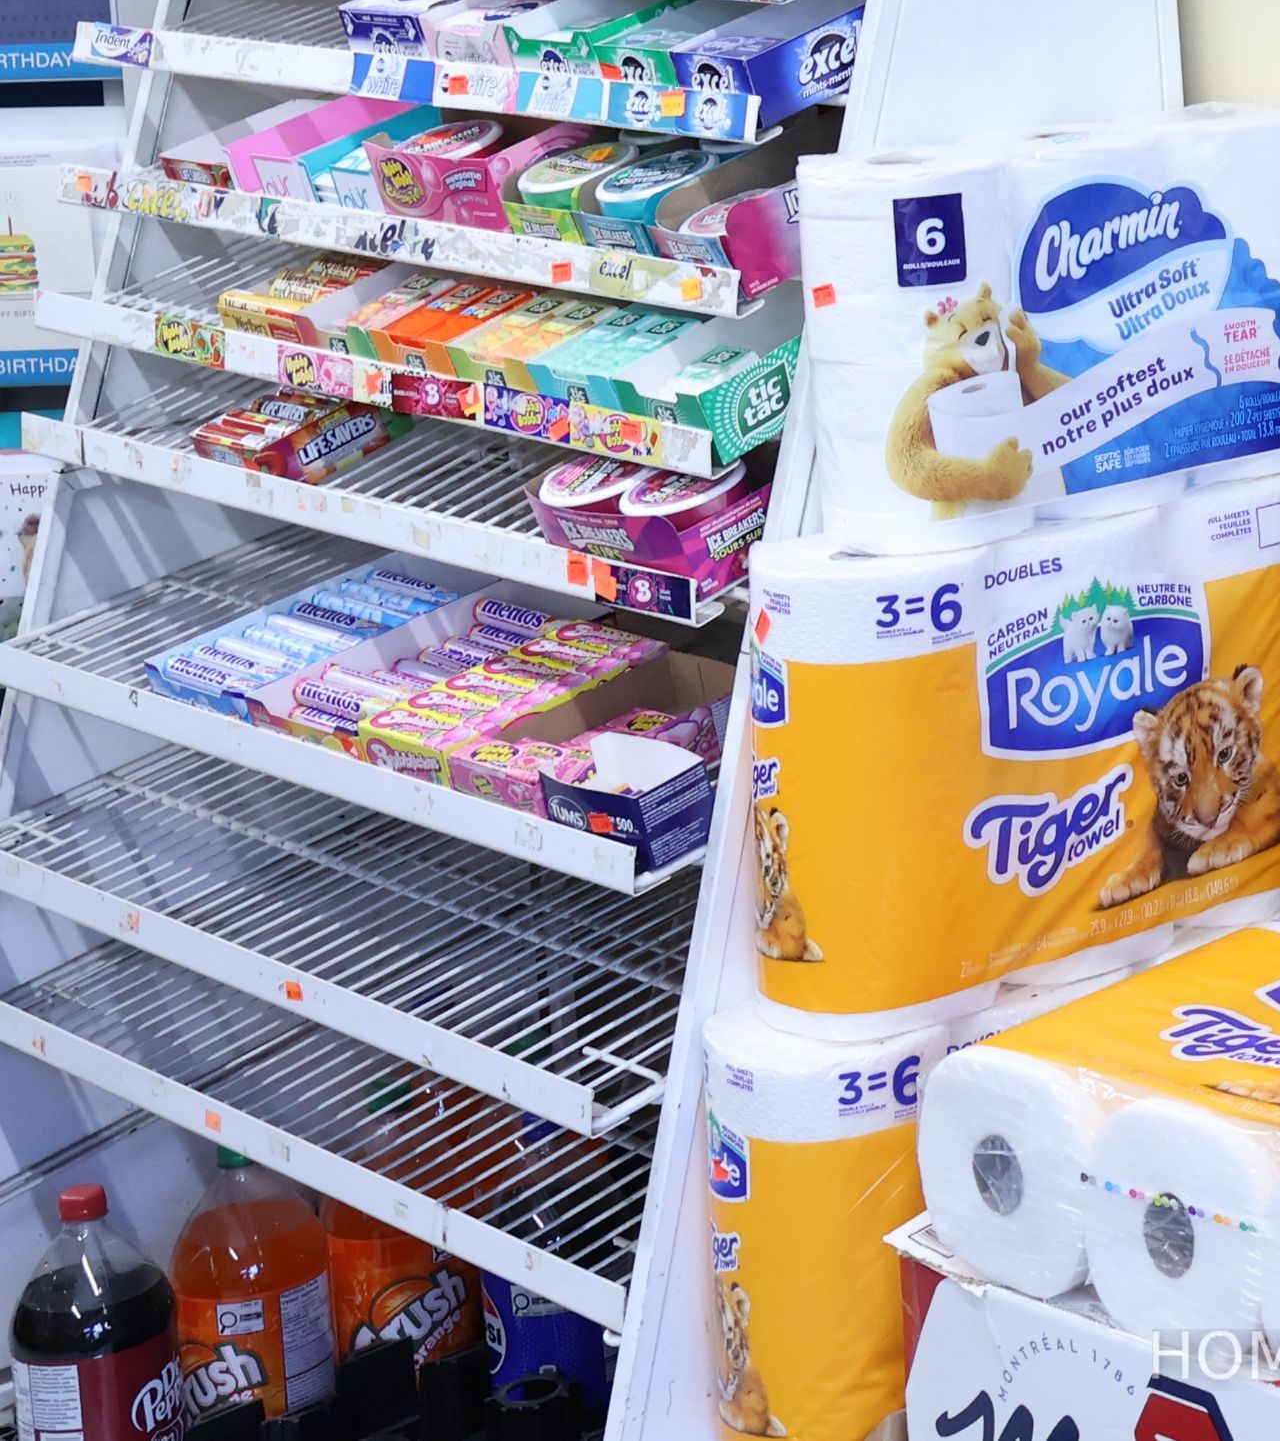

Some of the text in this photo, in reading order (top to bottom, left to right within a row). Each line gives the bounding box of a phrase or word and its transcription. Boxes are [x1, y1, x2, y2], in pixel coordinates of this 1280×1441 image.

[915, 217, 946, 256] 6
[1034, 191, 1182, 292] Charmin
[1107, 258, 1199, 320] Ultra Soft
[1116, 279, 1211, 342] Ultra Doux
[1224, 319, 1256, 331] SMOOTH
[1224, 328, 1257, 344] TEAR
[1224, 347, 1270, 365] SE DÉTACHE
[1225, 359, 1271, 374] EN DOUCEUR
[743, 391, 785, 425] tac
[747, 375, 781, 404] tic
[1041, 416, 1098, 456] notre
[1101, 391, 1144, 432] plus
[1146, 365, 1195, 401] doux
[1059, 356, 1168, 426] our softest
[983, 557, 1064, 591] DOUBLES
[875, 582, 964, 632] 3=6
[1006, 633, 1189, 734] Royale
[551, 799, 584, 827] TUMS
[970, 769, 1128, 890] Tiger
[1067, 815, 1122, 864] towel
